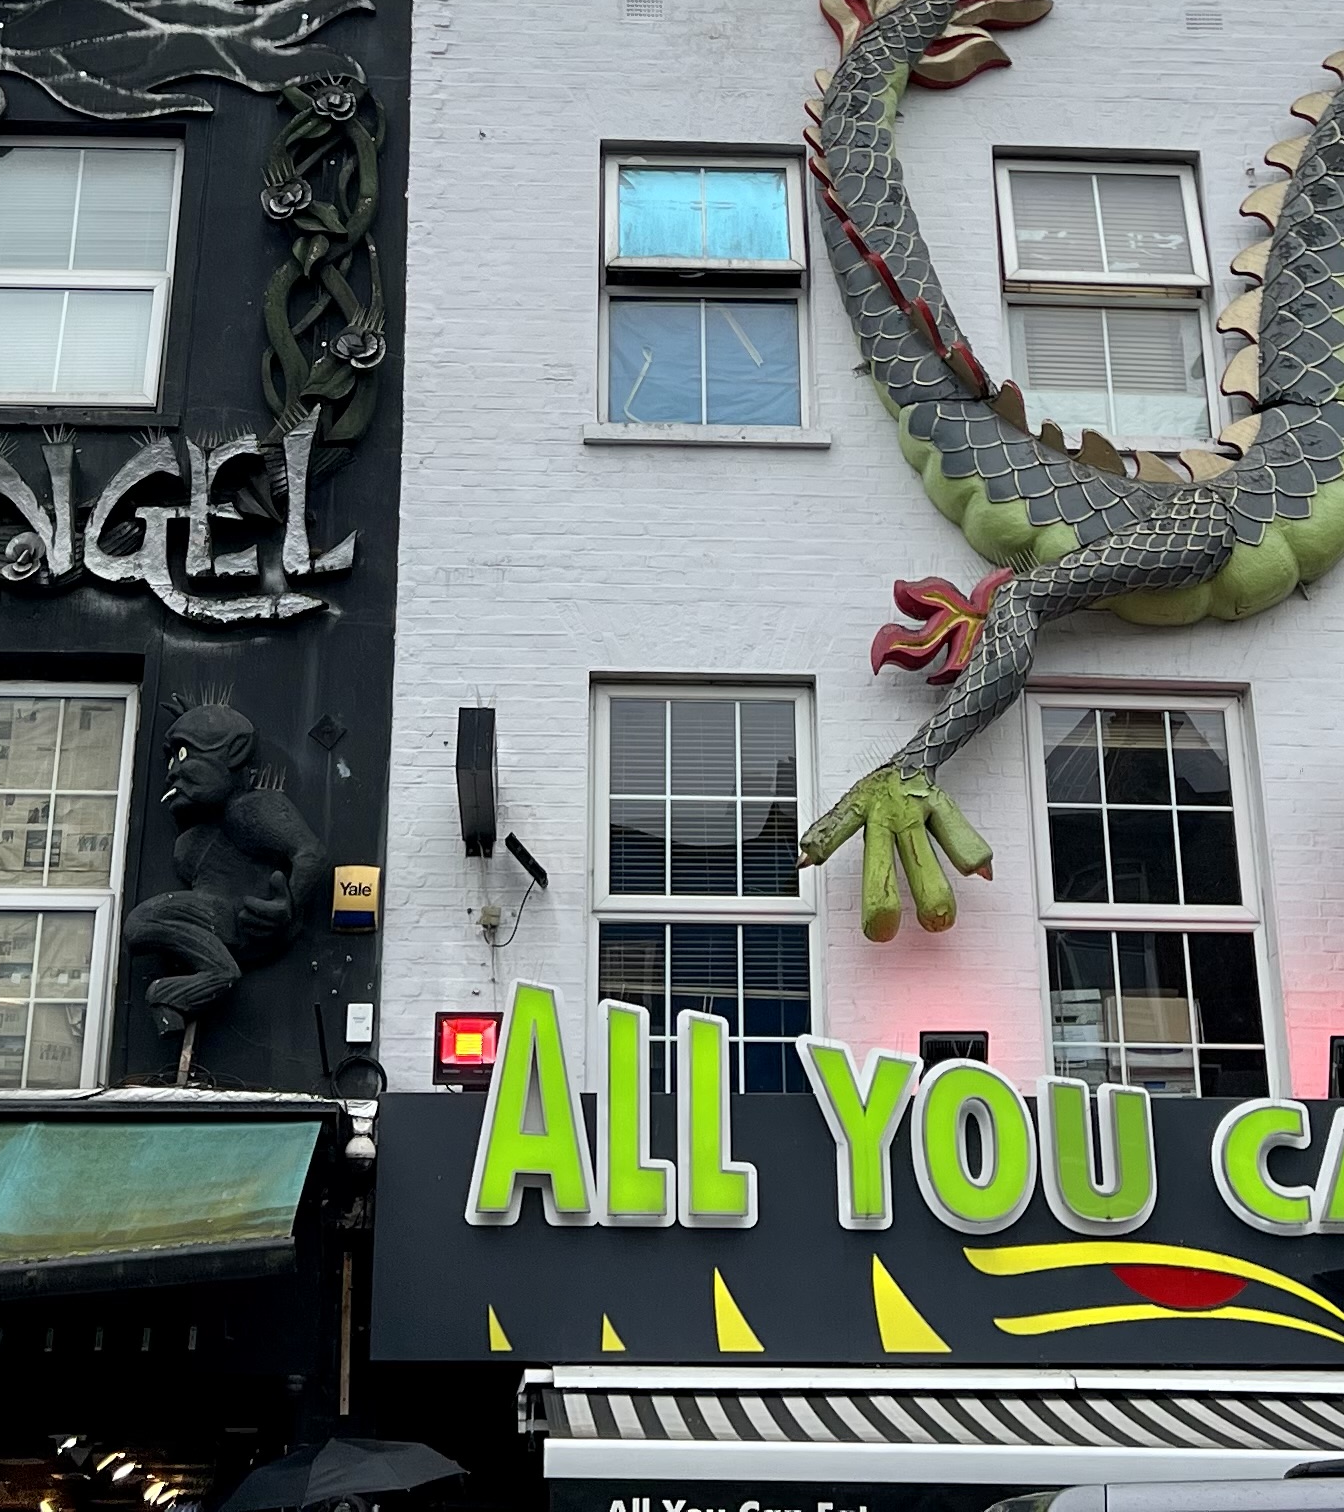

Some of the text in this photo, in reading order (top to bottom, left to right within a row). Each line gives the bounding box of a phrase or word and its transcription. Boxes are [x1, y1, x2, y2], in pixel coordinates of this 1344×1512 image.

[340, 882, 372, 896] Yale
[464, 978, 757, 1228] ALL
[796, 1034, 1156, 1234] YOU
